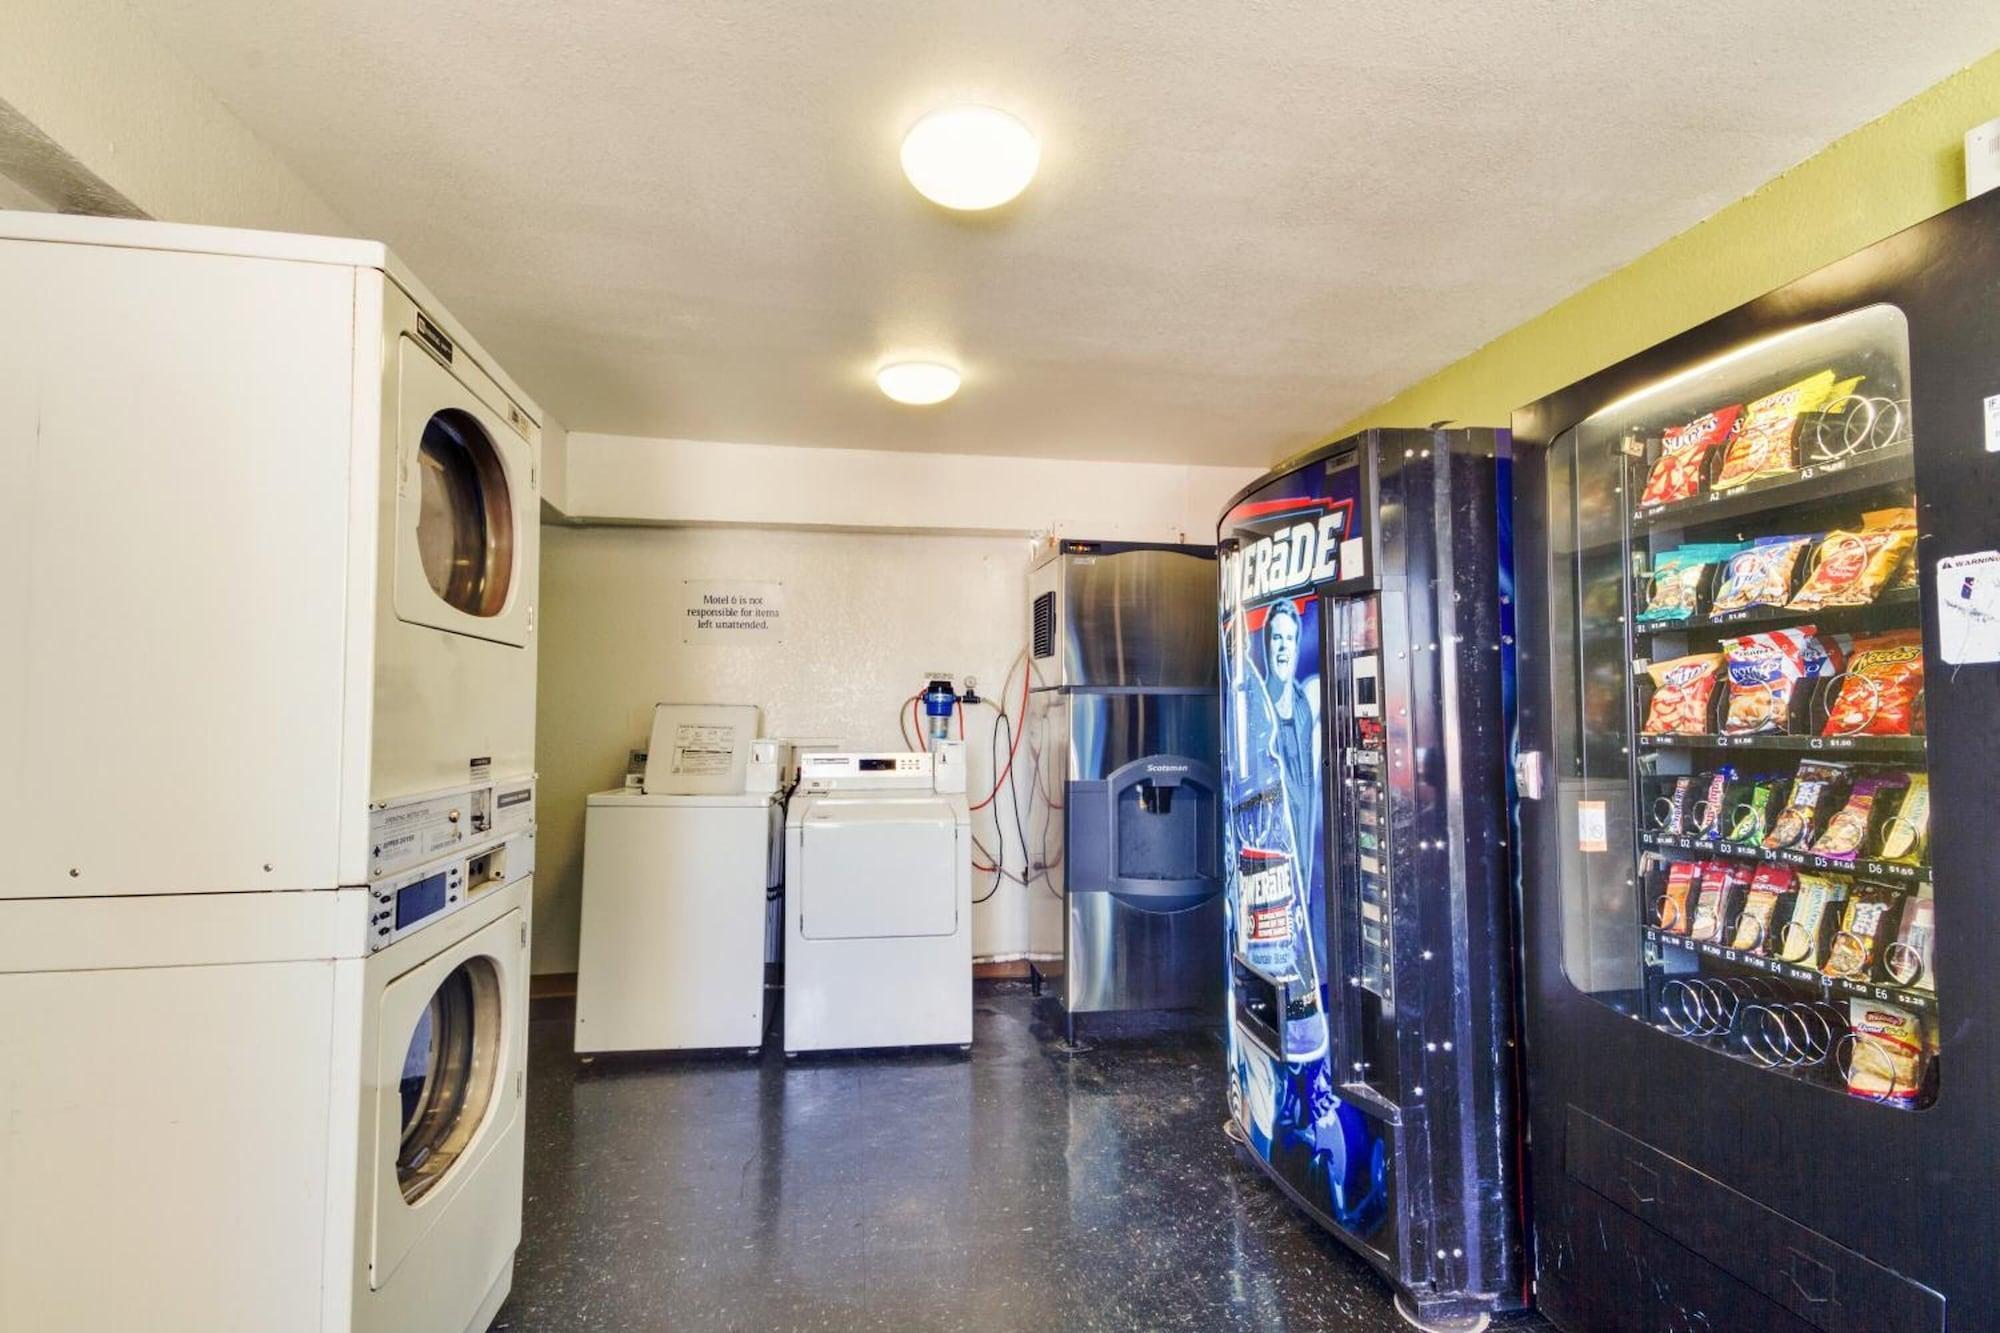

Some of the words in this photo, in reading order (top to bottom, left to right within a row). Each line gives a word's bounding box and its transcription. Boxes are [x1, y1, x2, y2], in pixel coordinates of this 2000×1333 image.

[1801, 469, 1813, 480] A3
[1710, 492, 1720, 502] A2
[1633, 510, 1643, 520] A1
[703, 595, 729, 605] Motel
[731, 596, 737, 605] 6
[740, 595, 747, 605] is
[749, 597, 763, 605] not
[687, 608, 738, 619] responsible
[741, 608, 752, 617] for
[755, 608, 779, 617] items
[698, 619, 712, 629] left
[715, 620, 769, 630] unattended.
[1640, 737, 1650, 745] C1
[1717, 737, 1728, 746] C2
[1810, 739, 1823, 749] C3
[1145, 763, 1189, 773] Scotsman
[1643, 834, 1653, 843] D1
[1680, 839, 1690, 848] D2
[1720, 844, 1732, 853] D3
[1765, 851, 1777, 860] D4
[1815, 857, 1828, 867] D5
[1868, 863, 1883, 874] D6
[1647, 931, 1656, 940] E1
[1685, 940, 1694, 950] E2
[1726, 951, 1736, 961] E3
[1771, 961, 1781, 972] E4
[1821, 975, 1833, 986] E5
[1875, 988, 1888, 999] E6
